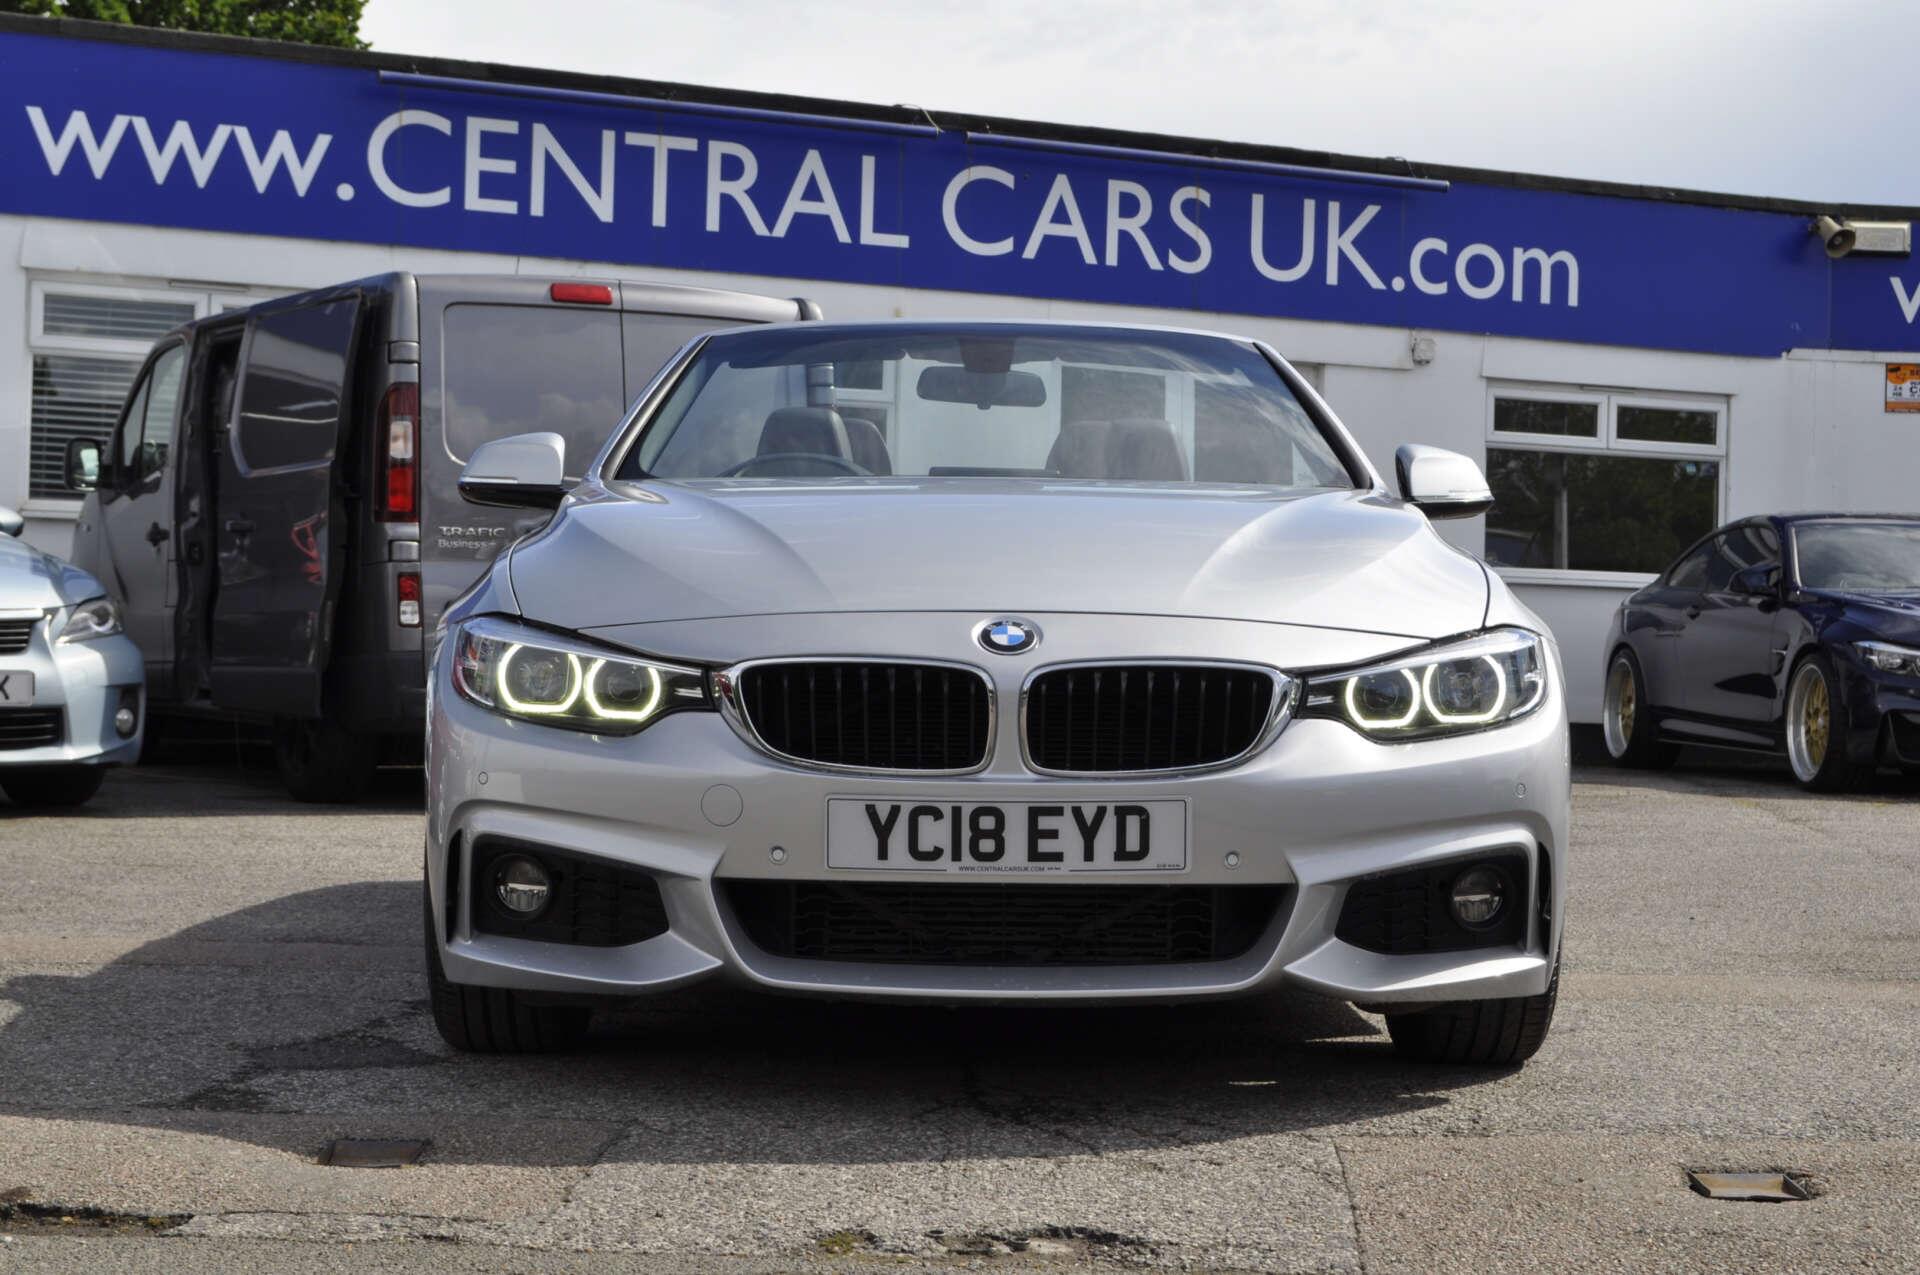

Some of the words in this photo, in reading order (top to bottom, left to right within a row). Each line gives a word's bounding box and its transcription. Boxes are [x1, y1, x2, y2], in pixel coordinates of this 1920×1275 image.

[942, 165, 1213, 275] CARS
[1250, 193, 1580, 308] UK.com
[439, 526, 505, 537] TRAFIC
[864, 803, 1006, 863] YC18
[1027, 804, 1151, 863] EYD
